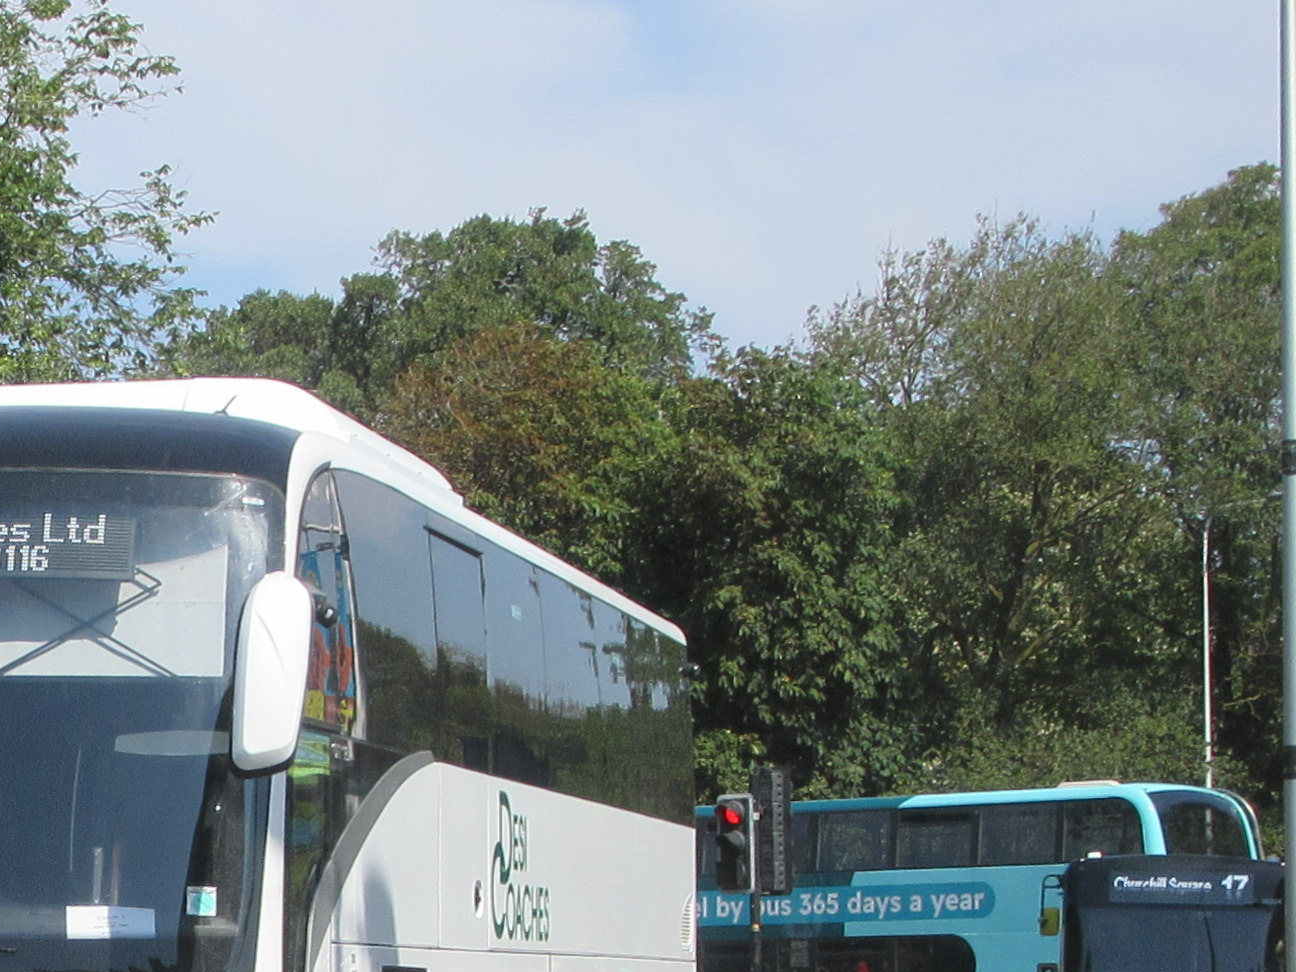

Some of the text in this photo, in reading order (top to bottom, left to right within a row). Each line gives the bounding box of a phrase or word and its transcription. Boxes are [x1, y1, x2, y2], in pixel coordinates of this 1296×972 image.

[42, 512, 107, 544] Ltd
[491, 841, 551, 943] COACHES
[716, 896, 744, 924] by
[798, 893, 840, 917] 365
[846, 890, 902, 919] days
[909, 894, 923, 912] a
[929, 891, 986, 918] year
